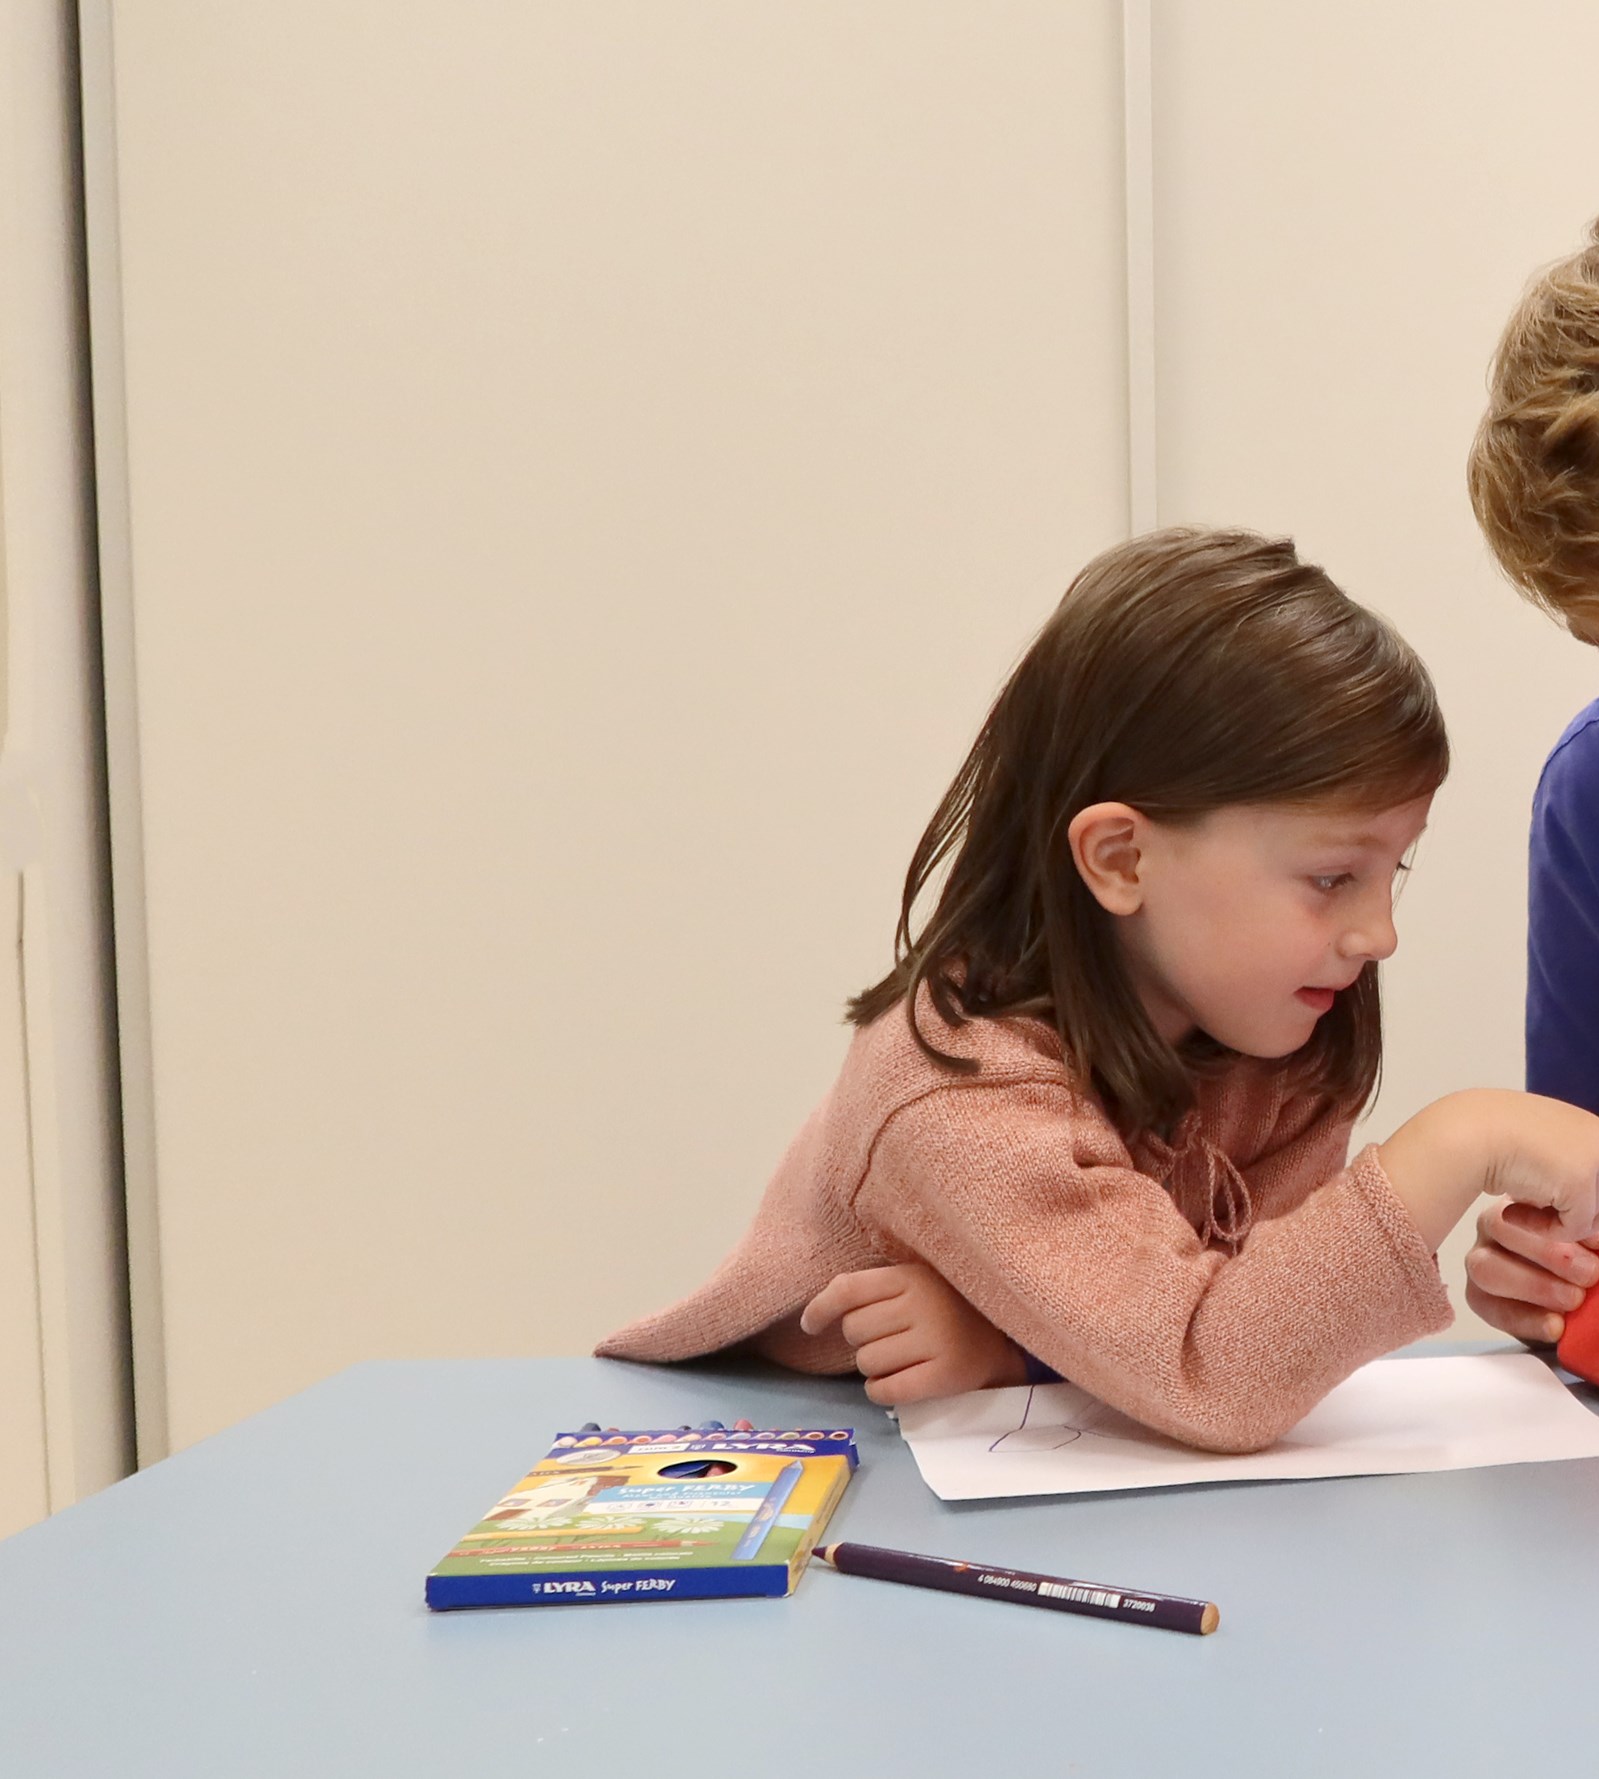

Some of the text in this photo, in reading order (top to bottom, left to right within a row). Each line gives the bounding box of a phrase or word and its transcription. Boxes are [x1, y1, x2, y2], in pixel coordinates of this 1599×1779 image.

[712, 1442, 815, 1452] LYRA
[543, 1578, 676, 1595] LYRA Super FERBY
